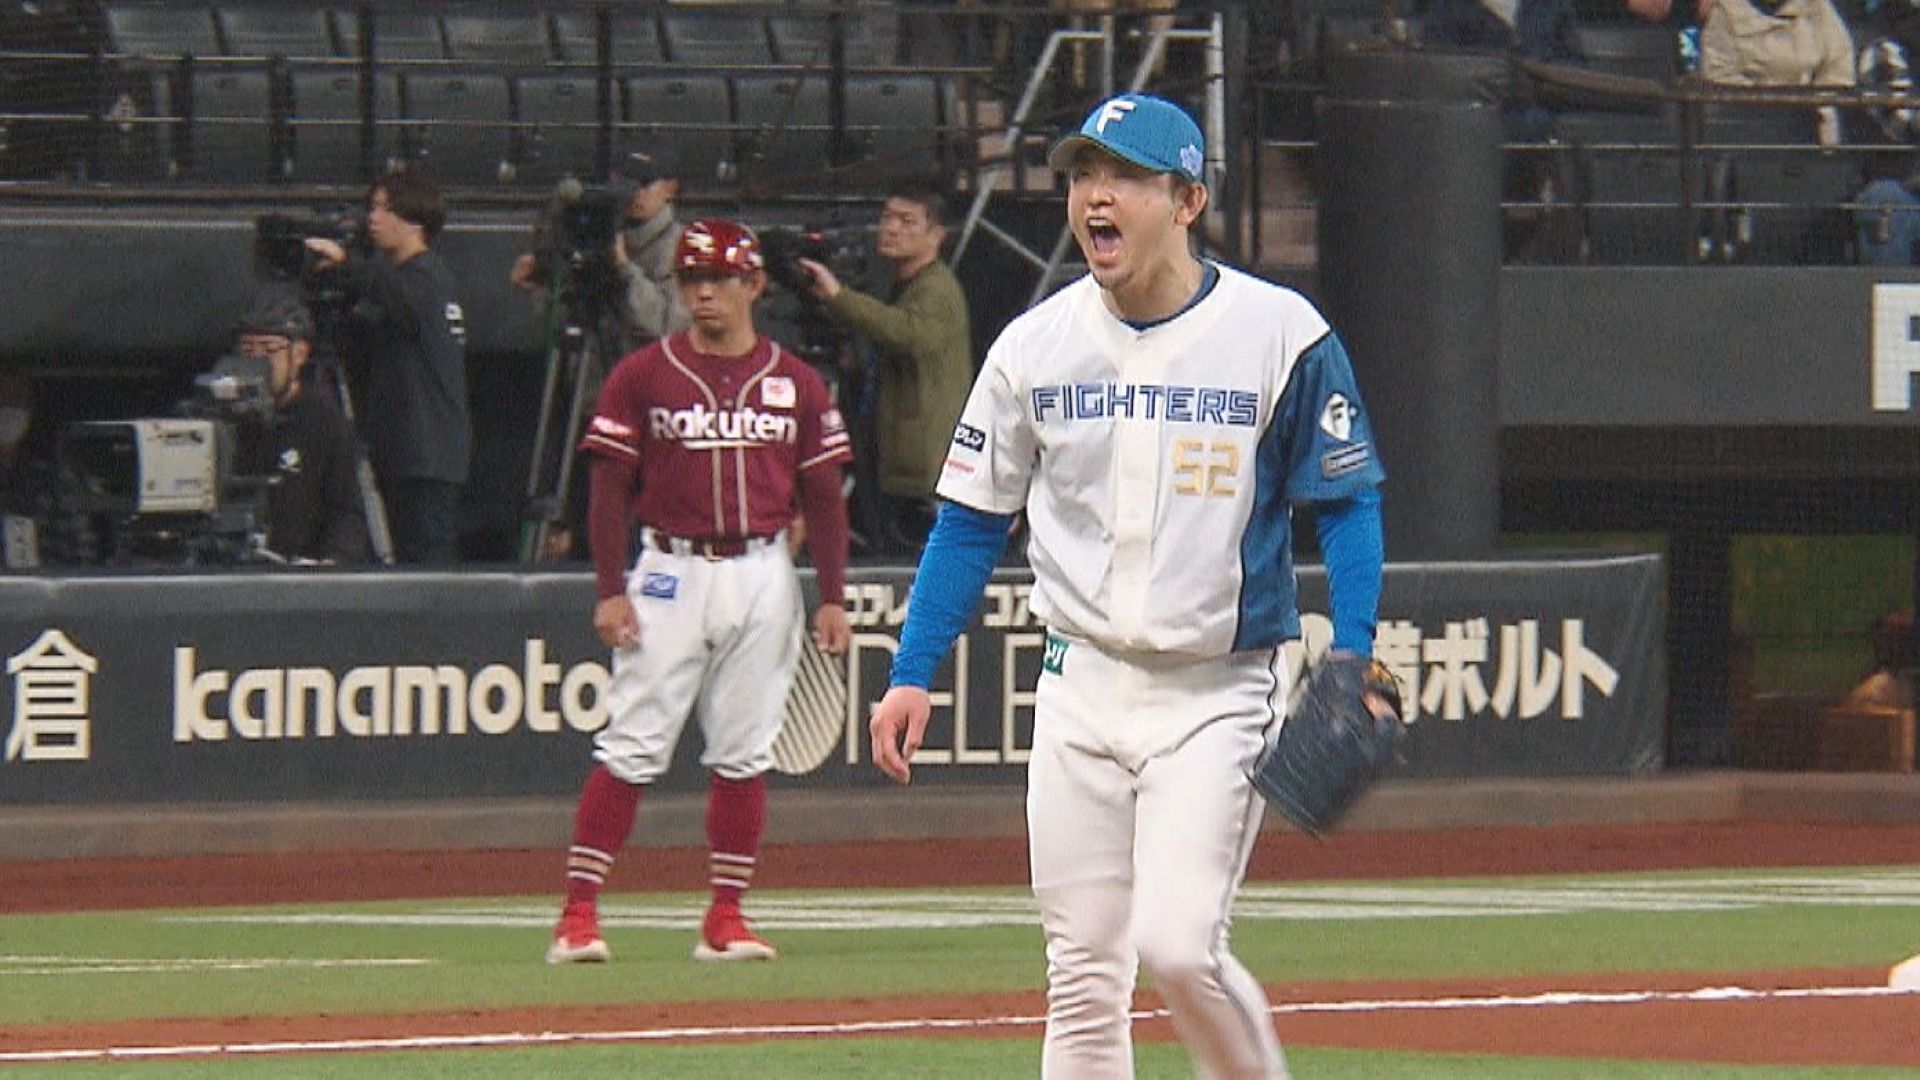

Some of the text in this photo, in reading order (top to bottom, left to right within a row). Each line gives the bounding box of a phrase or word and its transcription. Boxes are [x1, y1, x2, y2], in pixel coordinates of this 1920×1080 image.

[1096, 100, 1137, 133] F
[650, 403, 798, 445] Rakuten
[1032, 383, 1260, 427] FIGHTERS
[1172, 439, 1241, 496] 52
[5, 629, 97, 762] 倉
[173, 638, 612, 742] kanamoto
